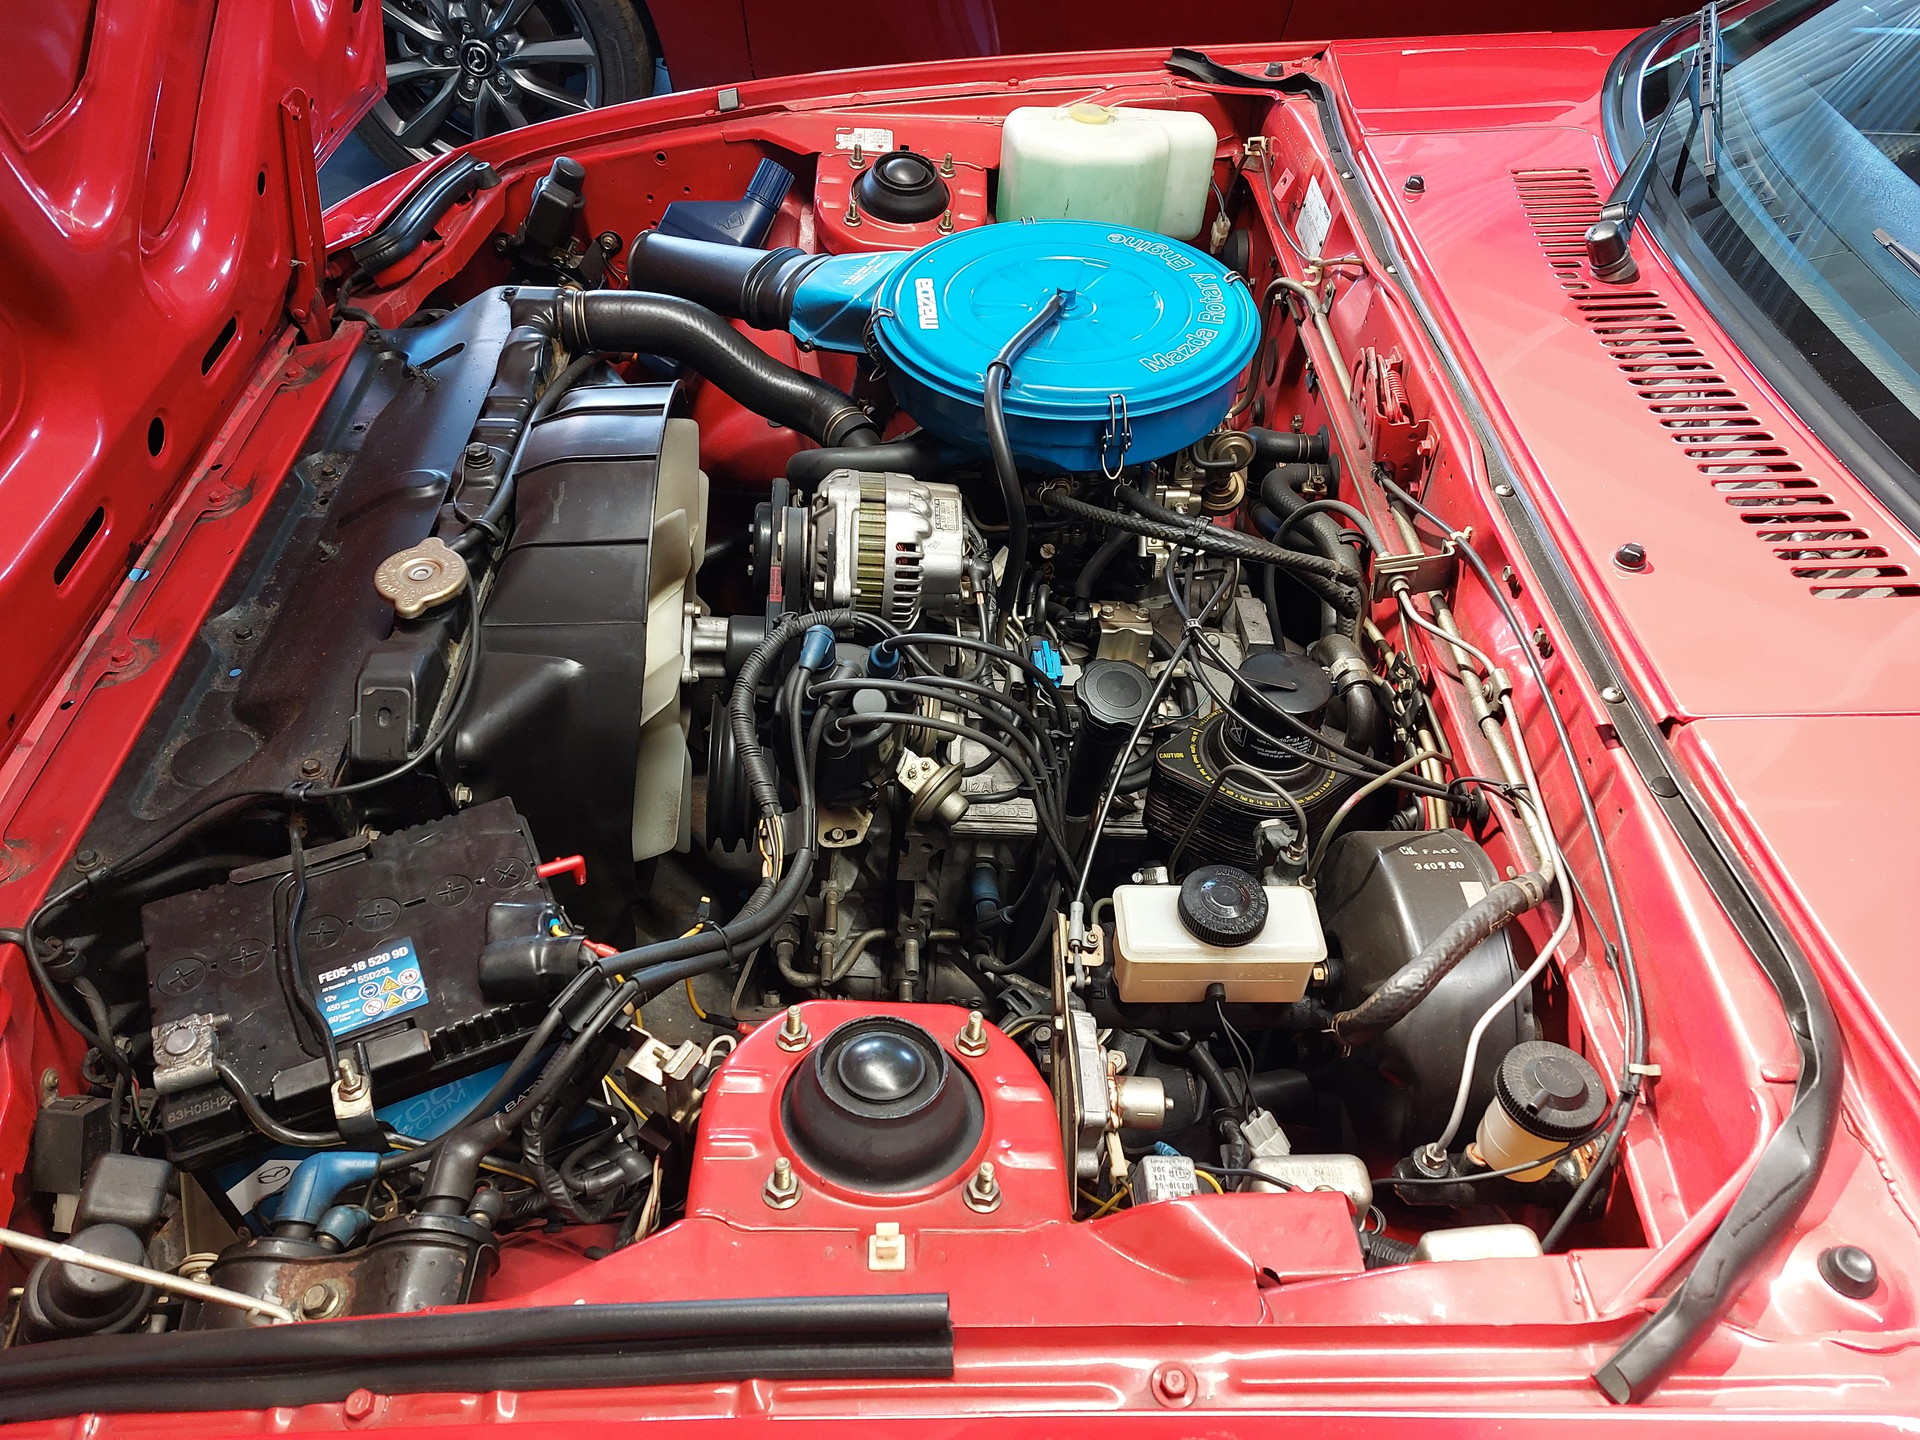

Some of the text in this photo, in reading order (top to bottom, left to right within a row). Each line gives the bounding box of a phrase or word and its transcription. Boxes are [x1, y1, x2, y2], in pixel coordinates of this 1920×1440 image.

[915, 278, 940, 330] mazda
[1106, 233, 1227, 373] Mazda Rotary Engine
[1159, 752, 1185, 760] CAUTION
[318, 946, 408, 984] FE05-18 520 9D
[357, 968, 393, 984] 55D23L
[326, 1003, 341, 1013] 450
